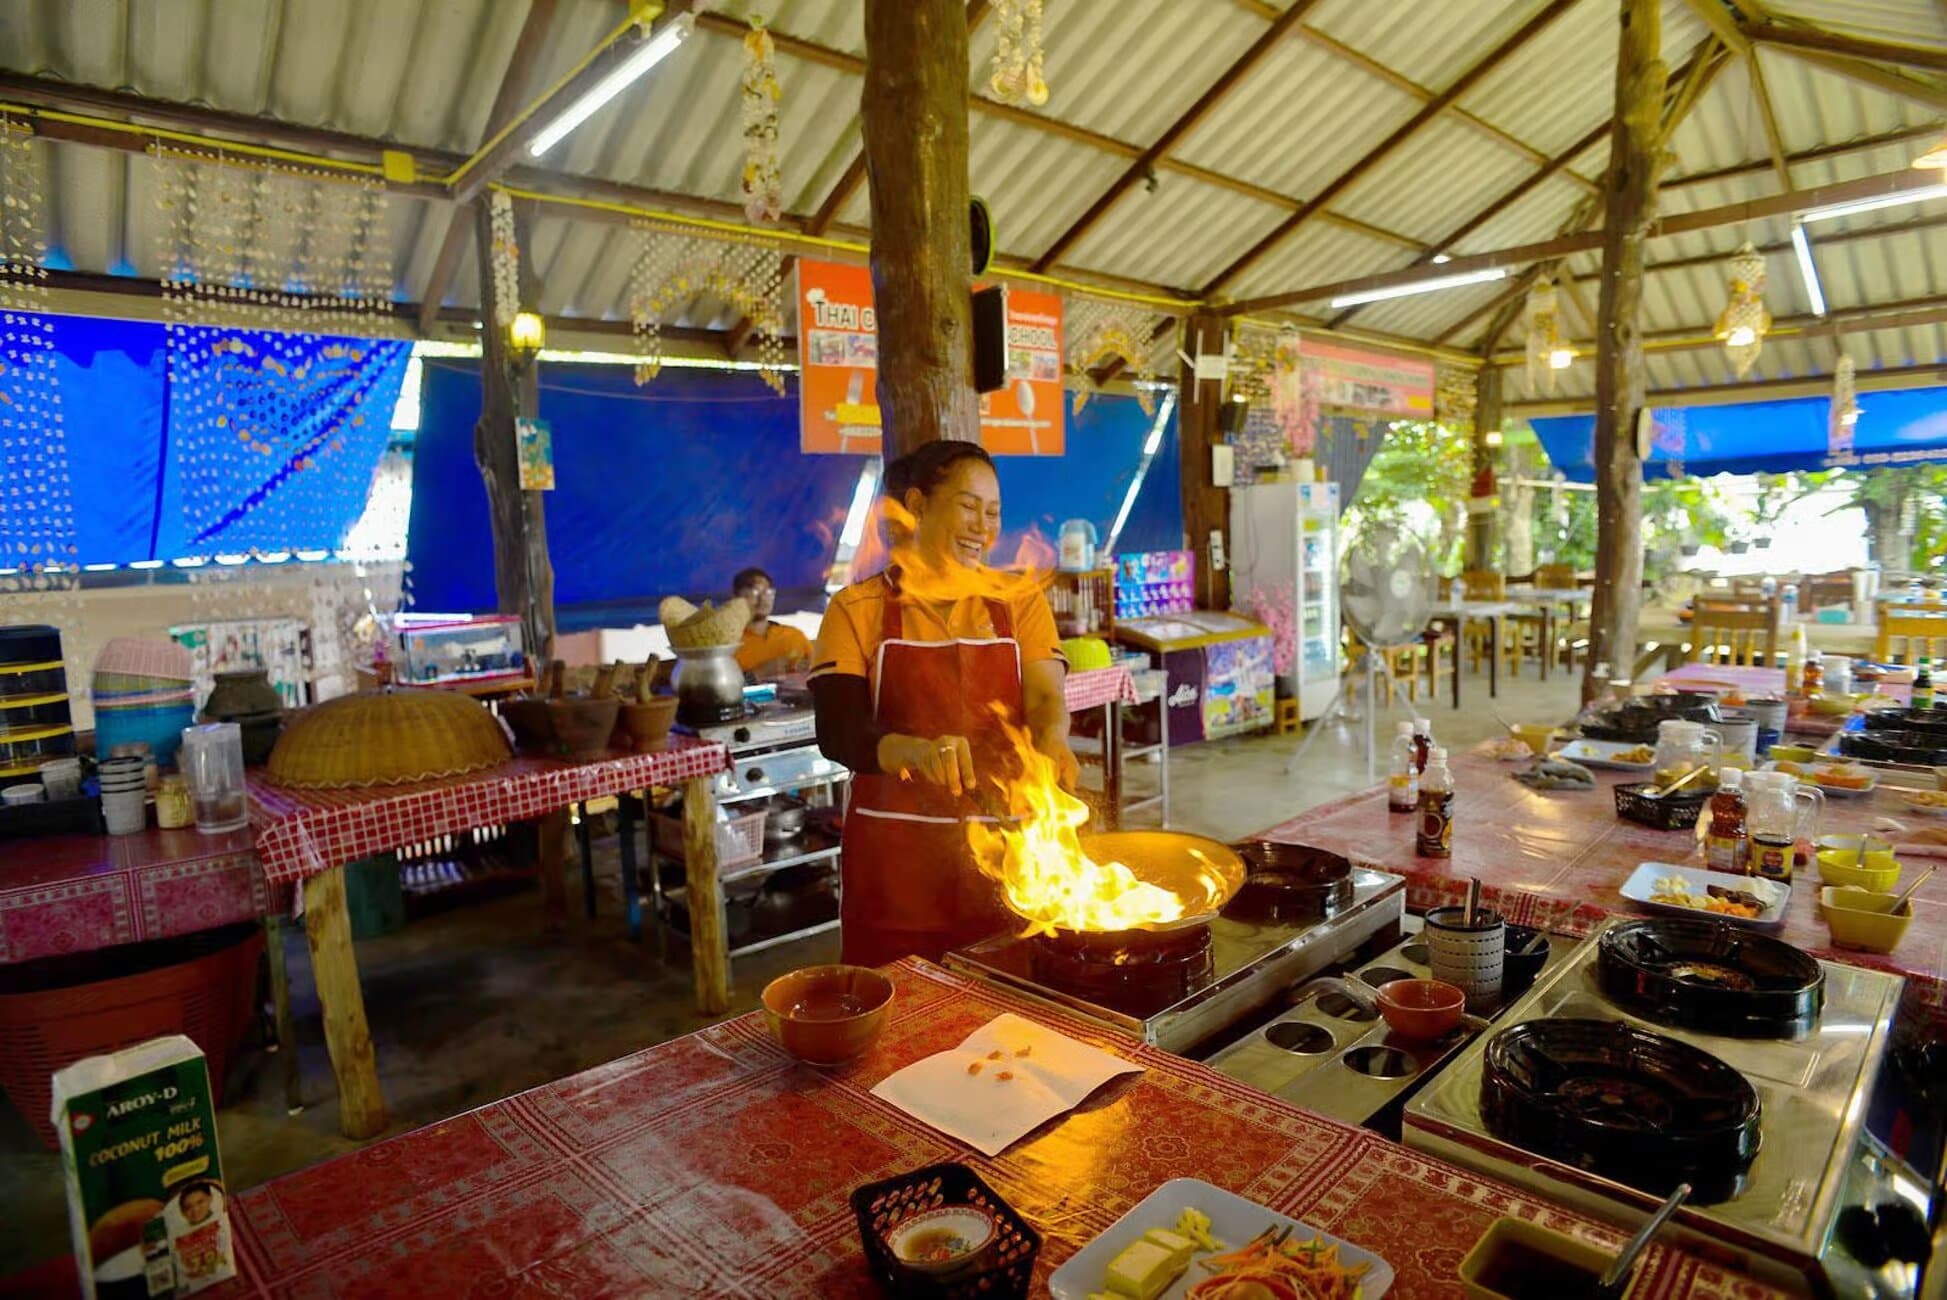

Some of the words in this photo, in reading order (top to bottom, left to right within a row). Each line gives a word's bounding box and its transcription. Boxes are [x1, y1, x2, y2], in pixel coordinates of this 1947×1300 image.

[815, 300, 858, 329] THAI
[1008, 325, 1057, 348] CHOOL
[107, 1087, 178, 1119] AROY-D
[88, 1131, 160, 1167] COCONUT
[167, 1117, 201, 1140] MILK
[154, 1132, 204, 1162] 100%
